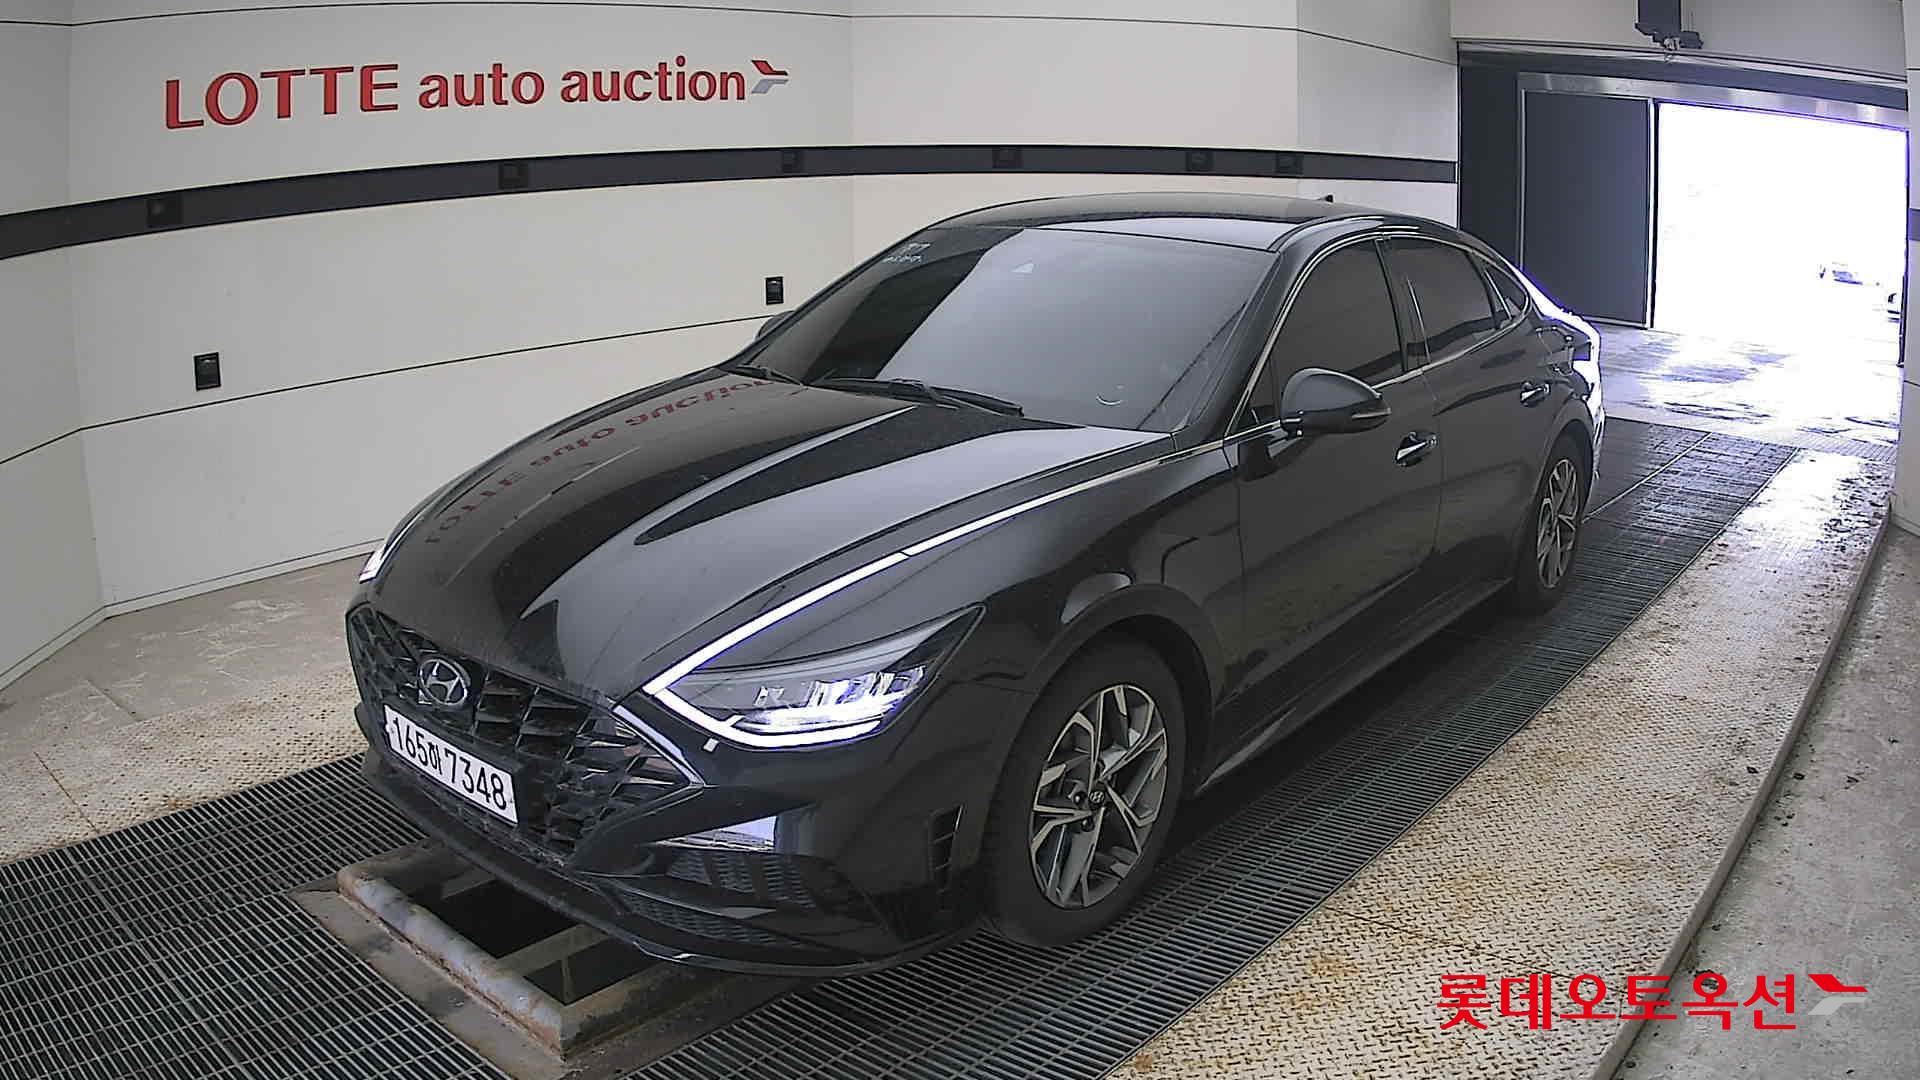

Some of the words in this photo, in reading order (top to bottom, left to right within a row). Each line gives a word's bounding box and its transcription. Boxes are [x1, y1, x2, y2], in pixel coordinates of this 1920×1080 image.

[164, 63, 398, 129] LOTTE
[417, 63, 545, 109] auto
[560, 56, 746, 102] auction
